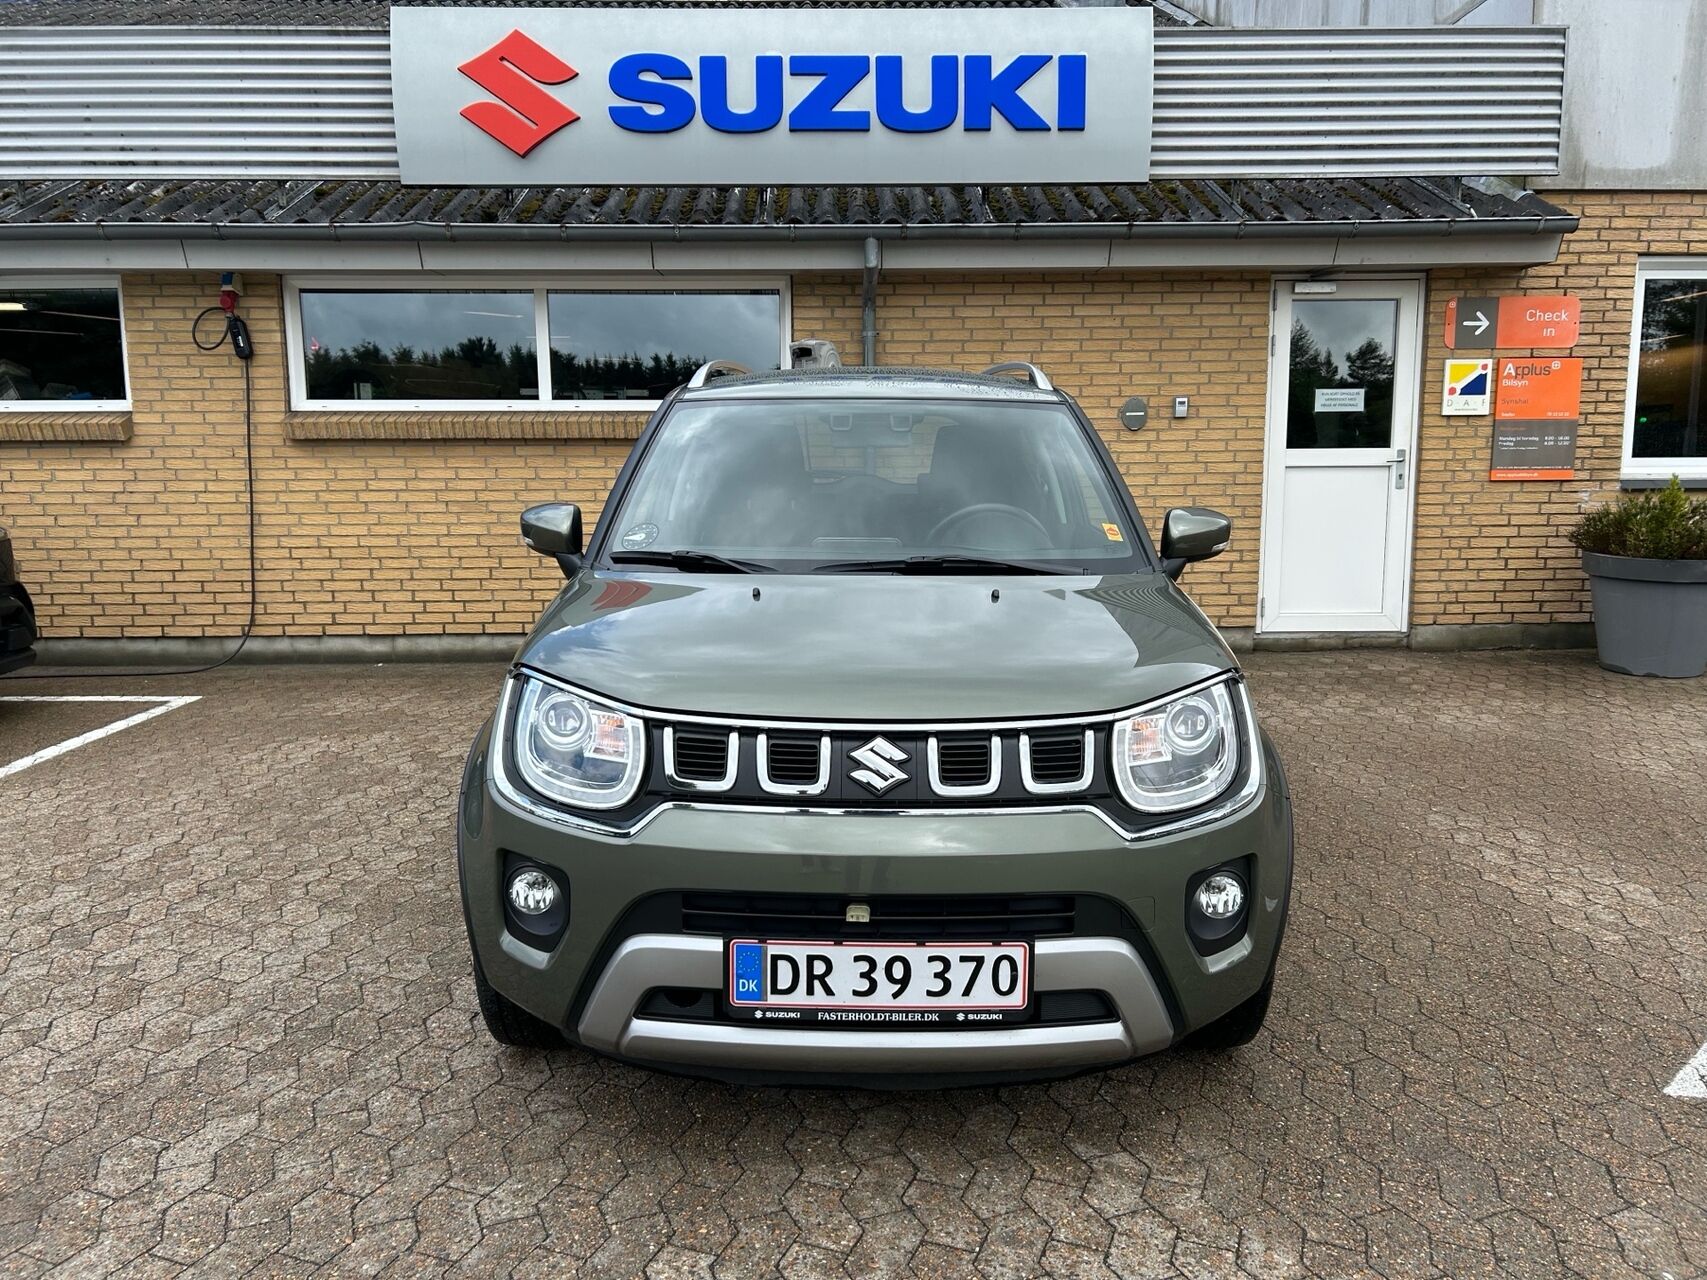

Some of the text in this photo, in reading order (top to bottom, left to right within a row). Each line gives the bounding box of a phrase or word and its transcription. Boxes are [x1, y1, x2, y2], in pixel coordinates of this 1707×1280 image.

[608, 53, 1087, 134] SUZUKI
[1526, 309, 1569, 321] Check
[1543, 327, 1555, 337] in
[1502, 379, 1529, 388] Bilsyn
[769, 954, 1019, 1000] DR 39 370
[739, 979, 758, 992] DK
[817, 1012, 940, 1022] FASTERHOLDT-BILER.DK
